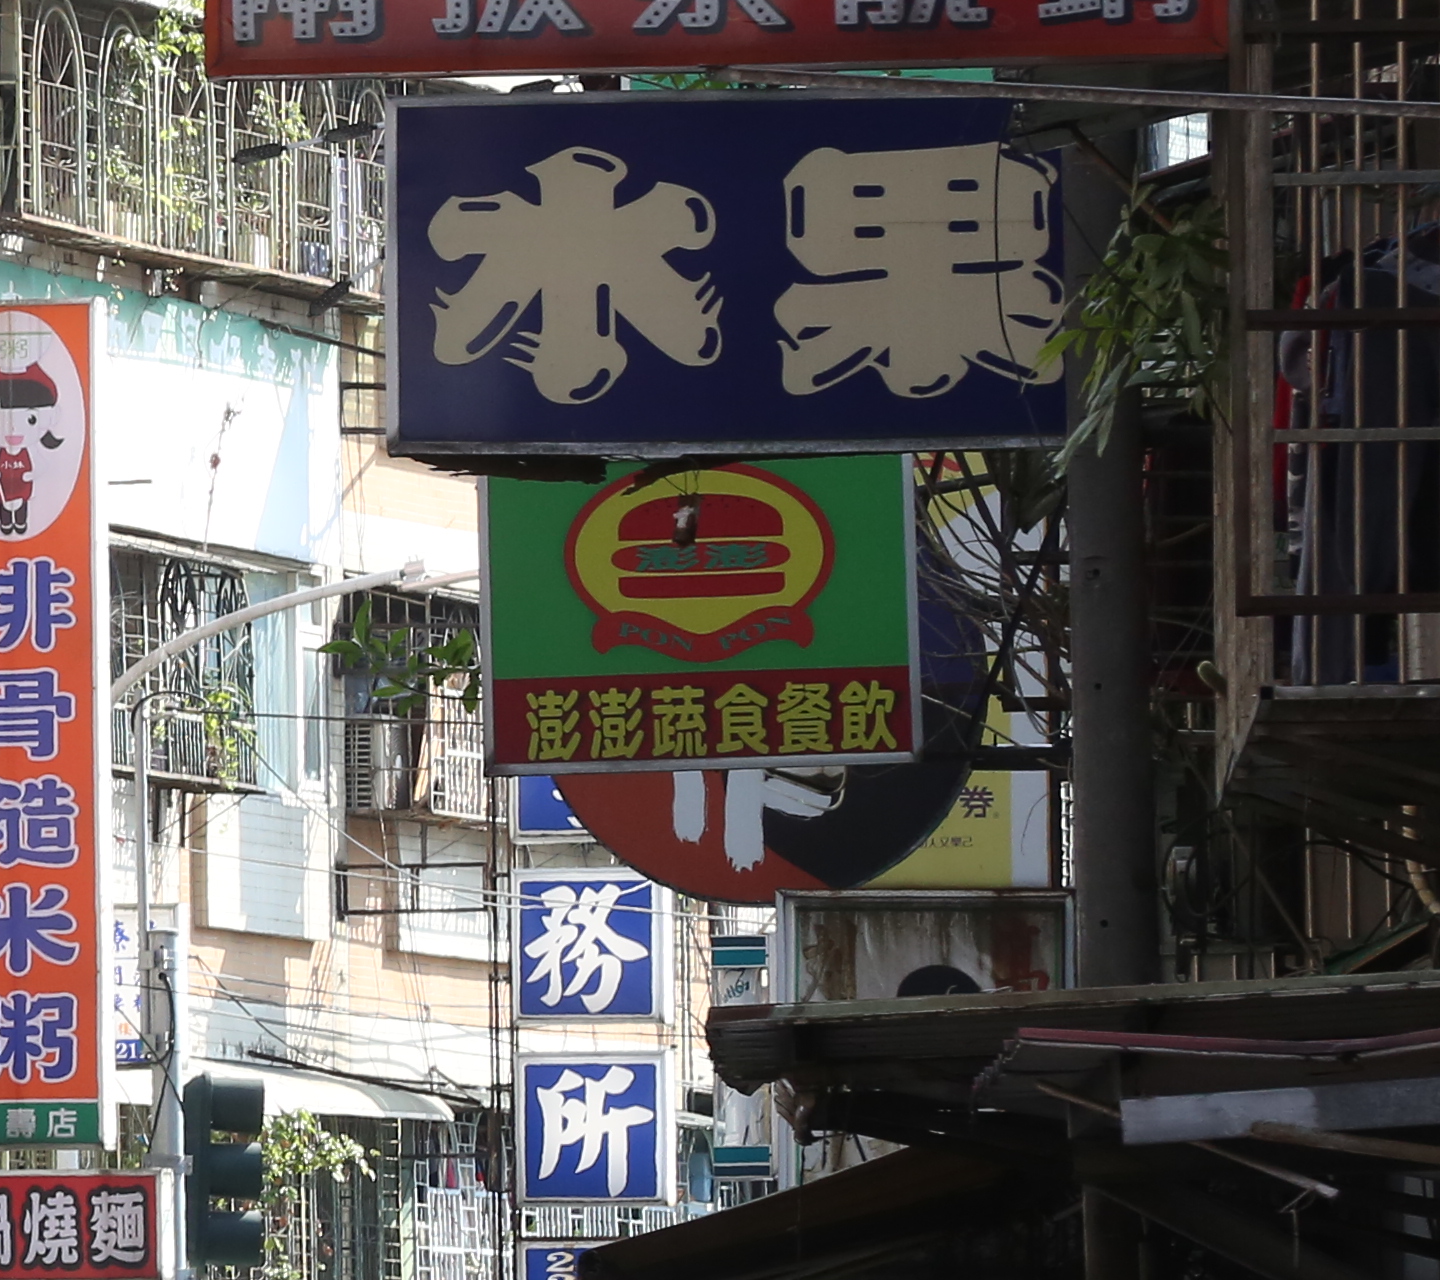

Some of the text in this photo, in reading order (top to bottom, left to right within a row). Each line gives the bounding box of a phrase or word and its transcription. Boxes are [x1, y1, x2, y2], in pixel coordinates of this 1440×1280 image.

[428, 144, 1065, 405] 水果
[526, 682, 899, 763] 澎澎蔬食餐飲
